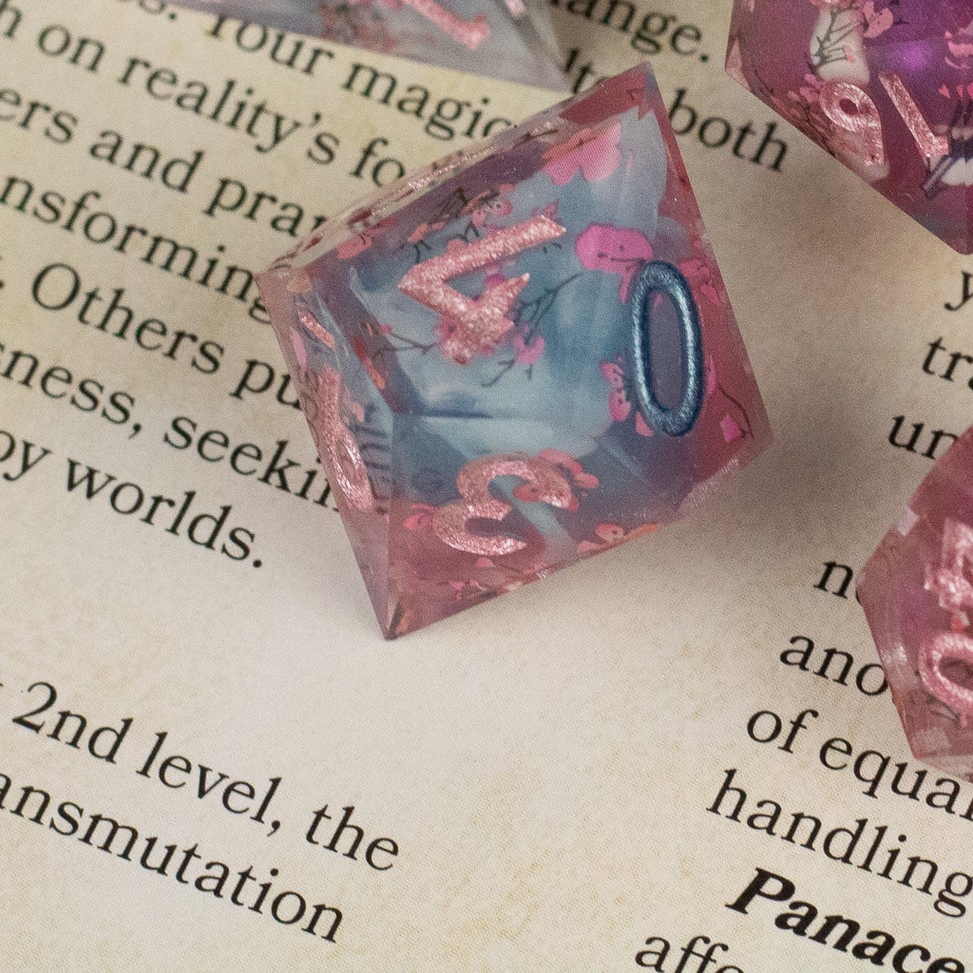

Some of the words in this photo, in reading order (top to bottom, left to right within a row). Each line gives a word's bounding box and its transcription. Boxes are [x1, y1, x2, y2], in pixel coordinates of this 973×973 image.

[37, 23, 107, 75] on
[88, 129, 206, 195] and
[668, 88, 790, 173] both
[31, 262, 226, 375] Others
[630, 258, 702, 438] 0
[66, 457, 264, 571] worlds.
[12, 681, 135, 765] 2nd
[136, 730, 284, 836] level,
[305, 805, 400, 872] the
[746, 708, 820, 755] of
[0, 771, 344, 945] nsmutation
